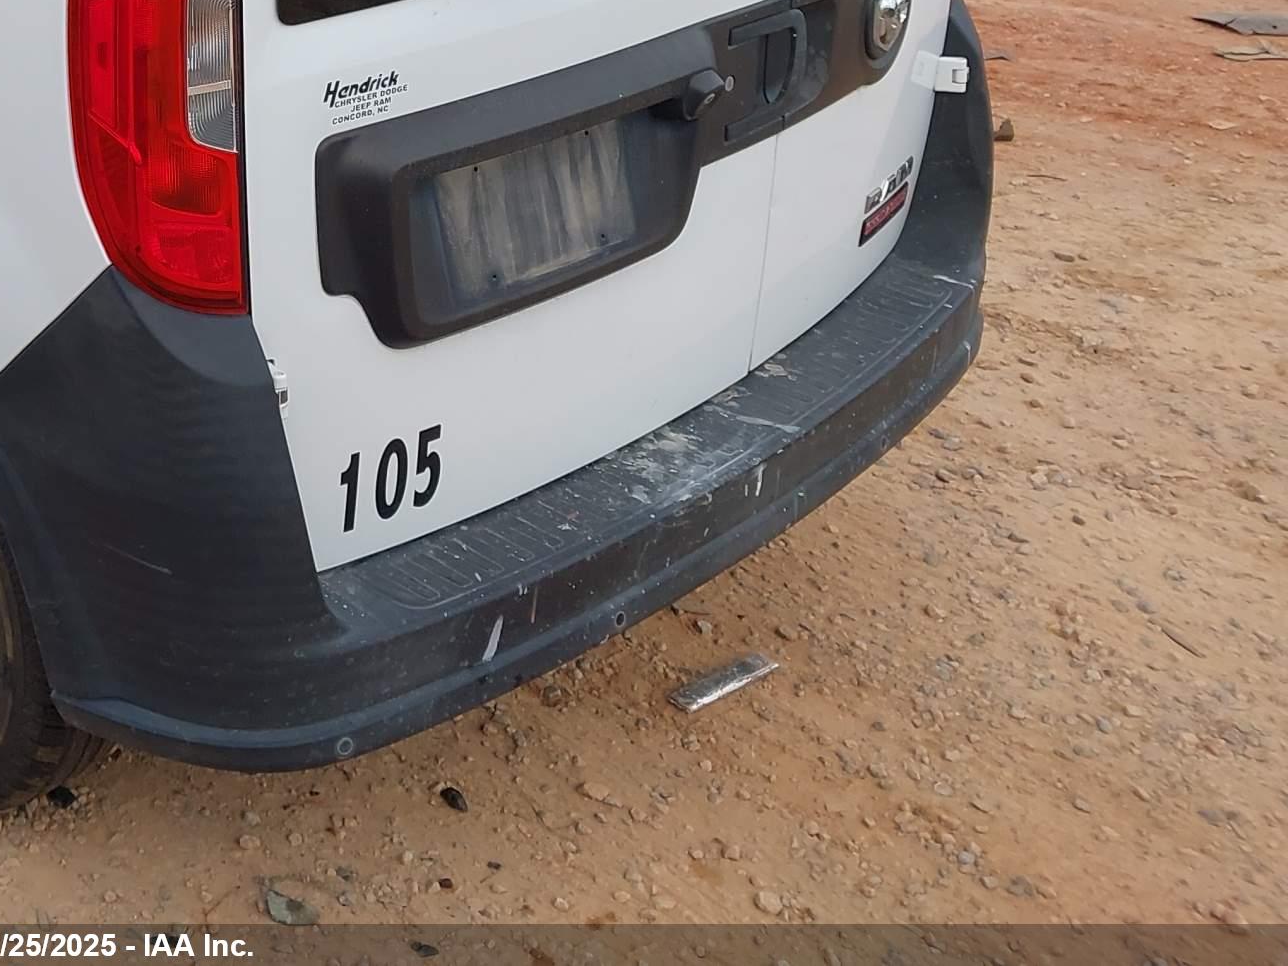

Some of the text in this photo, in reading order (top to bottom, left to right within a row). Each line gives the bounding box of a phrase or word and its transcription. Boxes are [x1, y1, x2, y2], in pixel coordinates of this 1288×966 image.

[323, 70, 399, 108] Hendrick
[334, 83, 408, 108] CHRYSLER DODGE
[332, 105, 389, 125] CONCORD, NC
[351, 96, 392, 113] JEEP RAM
[340, 423, 442, 533] 105
